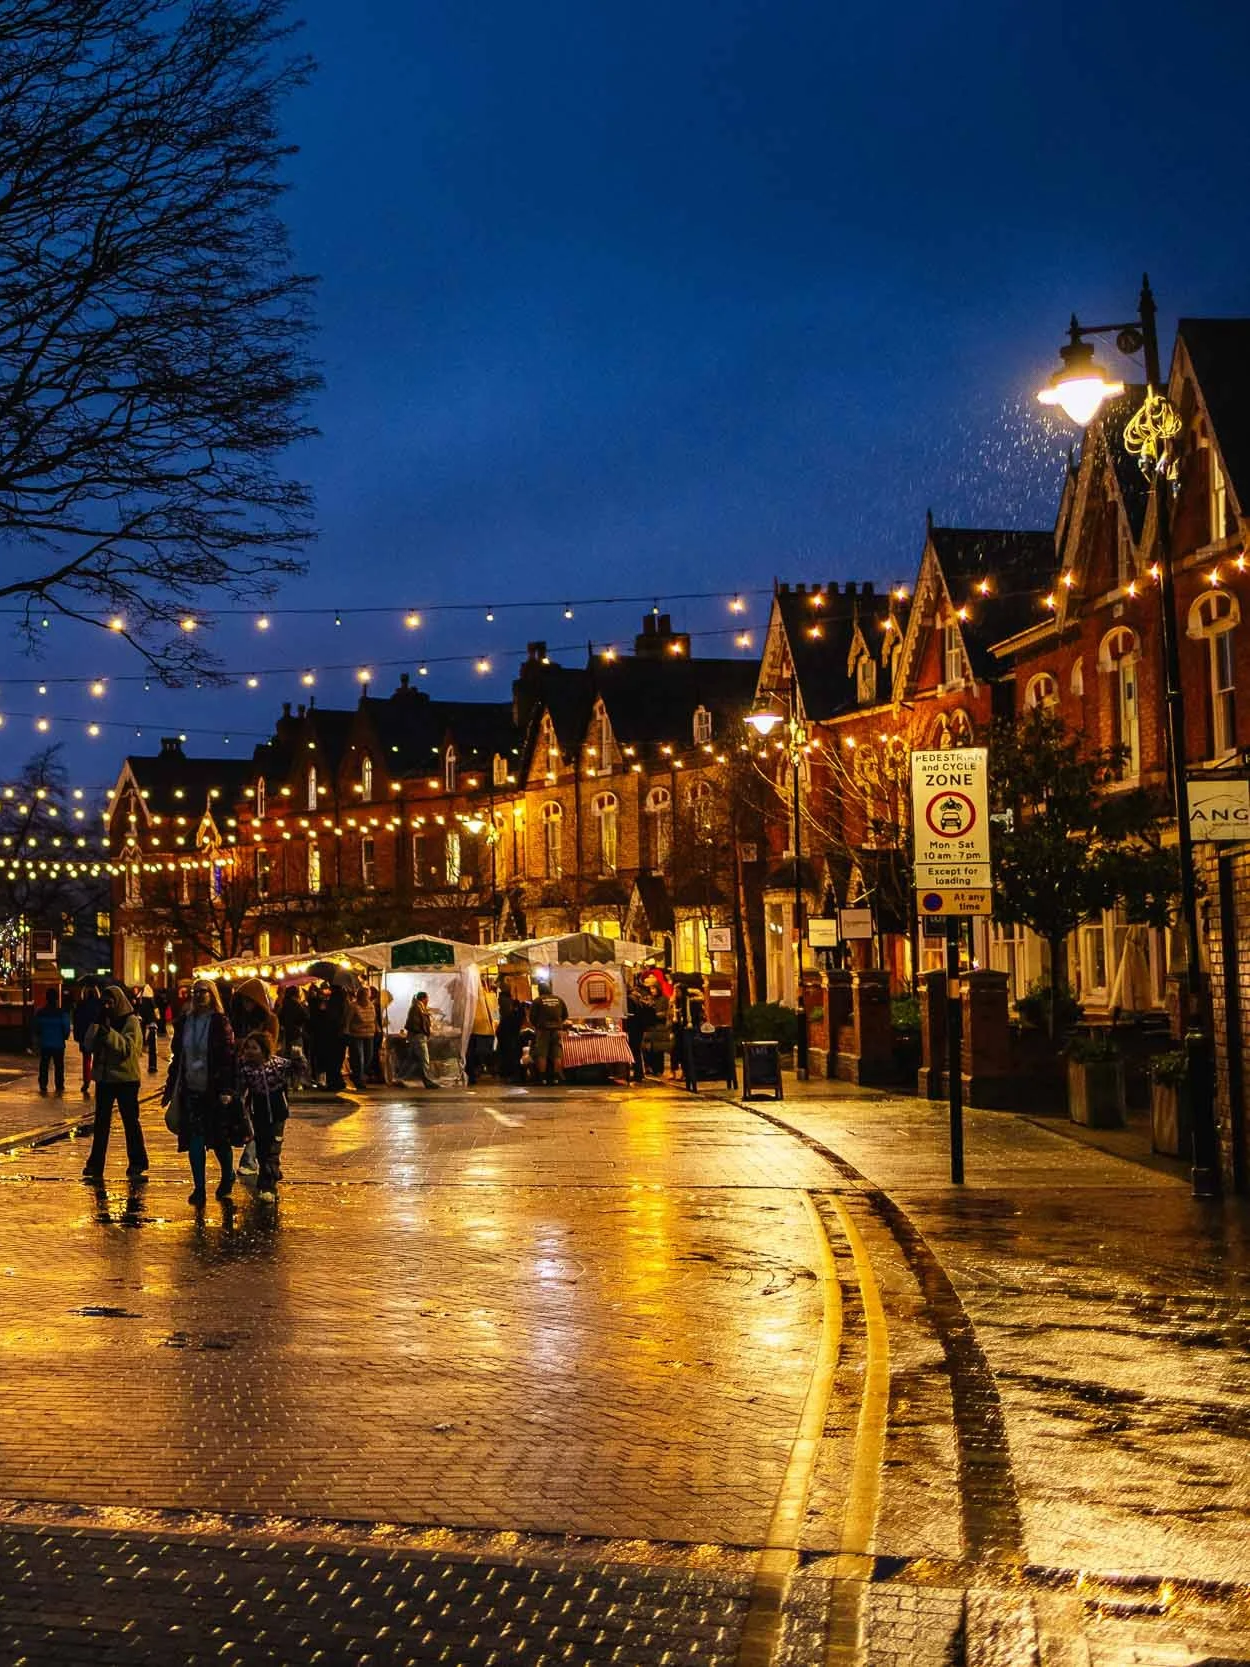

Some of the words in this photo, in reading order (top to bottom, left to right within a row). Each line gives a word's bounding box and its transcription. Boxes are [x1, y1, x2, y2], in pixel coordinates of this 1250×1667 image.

[922, 763, 939, 771] and
[942, 762, 977, 771] CYCLE
[925, 773, 973, 787] ZONE
[929, 840, 950, 849] Mon
[957, 840, 975, 849] Sat
[924, 851, 935, 860] 10
[927, 867, 961, 876] Except
[964, 866, 978, 875] for
[935, 876, 971, 886] loading
[954, 893, 965, 901] At
[968, 894, 985, 902] any
[959, 902, 980, 911] time
